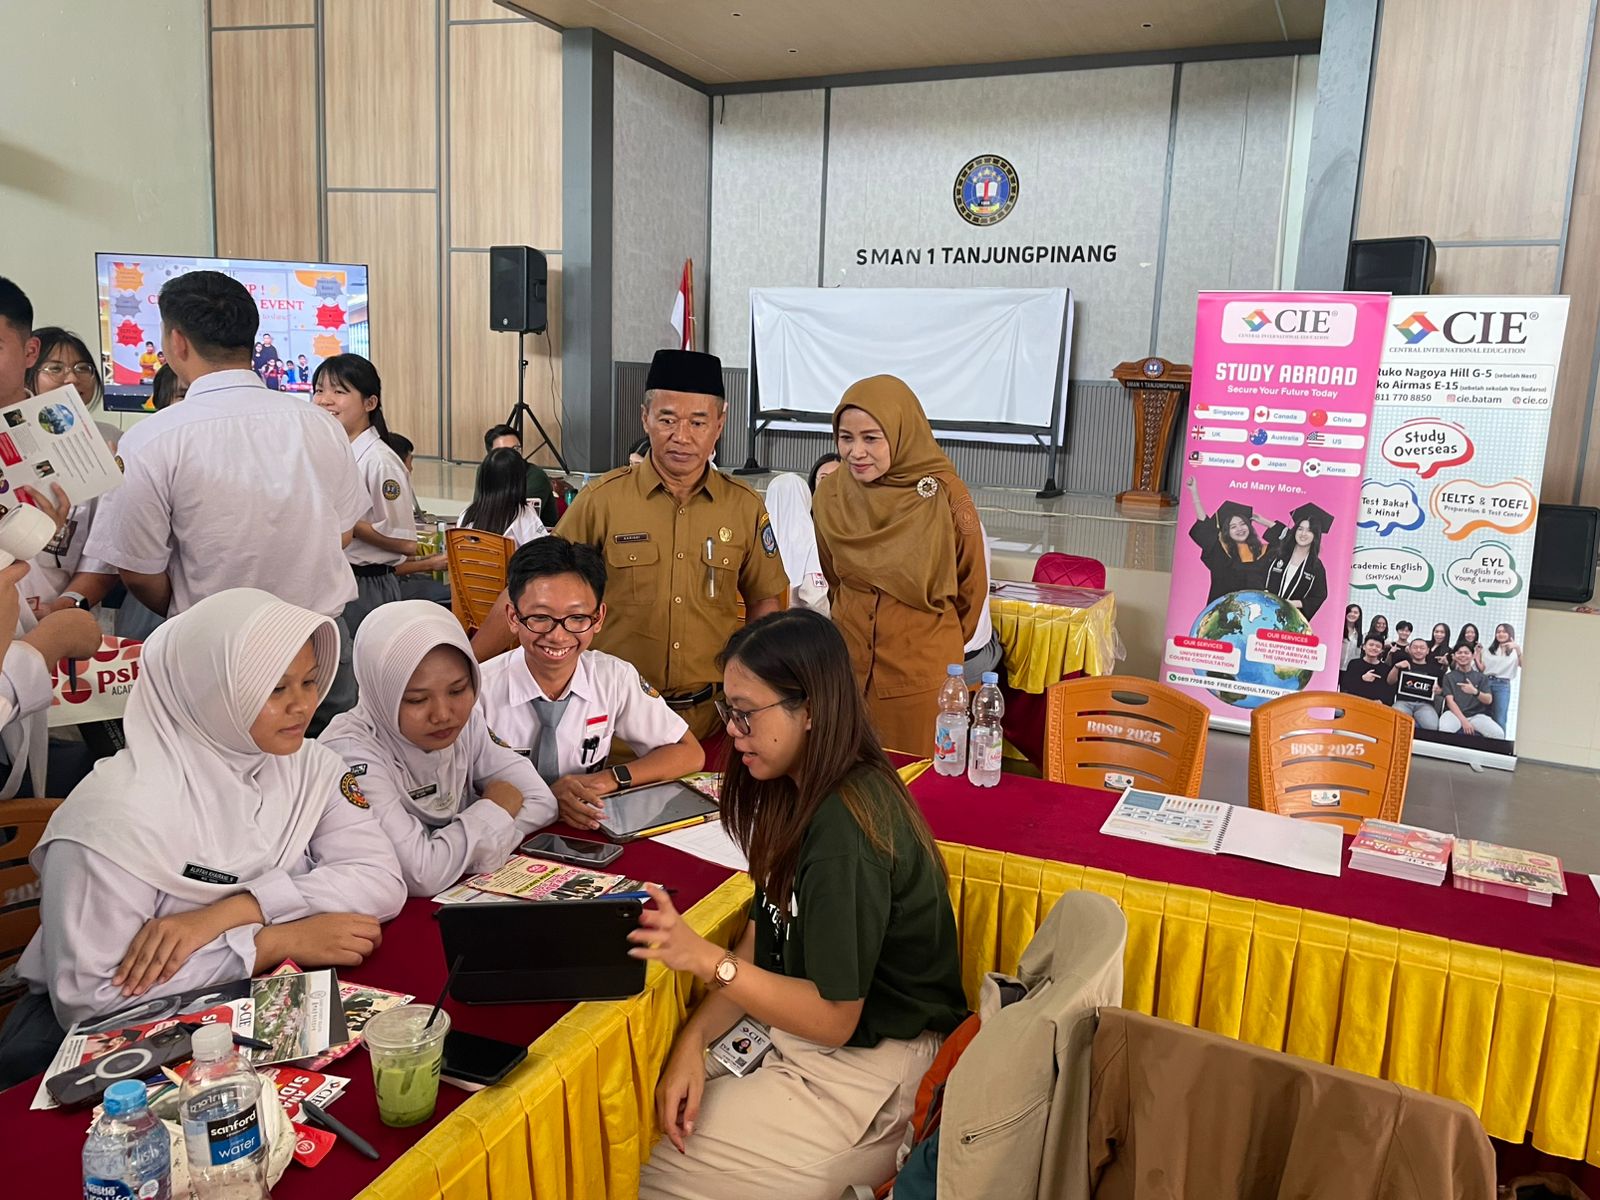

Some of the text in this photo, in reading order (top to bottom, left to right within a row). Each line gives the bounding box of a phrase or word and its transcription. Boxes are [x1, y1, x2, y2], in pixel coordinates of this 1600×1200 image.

[856, 244, 1117, 265] SMAN 1 TANJUNGPINANG
[260, 300, 304, 310] EVENT
[1274, 310, 1330, 333] CIE
[1443, 311, 1527, 344] CIE
[1216, 362, 1358, 386] STUDY ABROAD
[1405, 368, 1446, 379] Nagoya
[1450, 368, 1469, 377] Hill
[1472, 369, 1492, 378] G-5
[1392, 380, 1431, 389] Airmas
[1434, 381, 1458, 390] E-15
[1227, 385, 1338, 399] Secure Your Future Today
[1457, 395, 1502, 404] cie.batam
[1271, 434, 1299, 442] Australia
[1405, 430, 1446, 444] Study
[1394, 444, 1458, 456] Overseas
[1208, 456, 1235, 464] Malaysia
[1229, 480, 1306, 494] And Many More..
[1362, 497, 1409, 508] Test Bakat
[1441, 492, 1529, 510] IELTS & TOEFL
[1375, 509, 1400, 518] Minat
[1444, 505, 1480, 514] Preparation
[1488, 509, 1500, 517] Test
[1350, 562, 1422, 573] cademic English
[1482, 557, 1504, 567] EYL
[1462, 567, 1505, 577] (English for
[1454, 574, 1511, 585] Young Learners)
[1281, 633, 1308, 644] SERVICES
[1197, 641, 1223, 650] SERVICES
[1269, 643, 1294, 652] SUPPORT
[1296, 646, 1317, 654] BEFORE
[1274, 656, 1307, 665] UNIVERSITY
[1287, 651, 1310, 659] ARRIVAL
[1192, 658, 1234, 668] CONSULTATION
[1234, 684, 1280, 696] CONSULTATION
[1414, 681, 1430, 691] CIE
[1087, 720, 1161, 744] BOSP 2025
[1328, 743, 1365, 757] 2025
[239, 1010, 251, 1027] CIE
[749, 1032, 763, 1045] CIE
[211, 1110, 256, 1136] sanford
[219, 1137, 255, 1158] water
